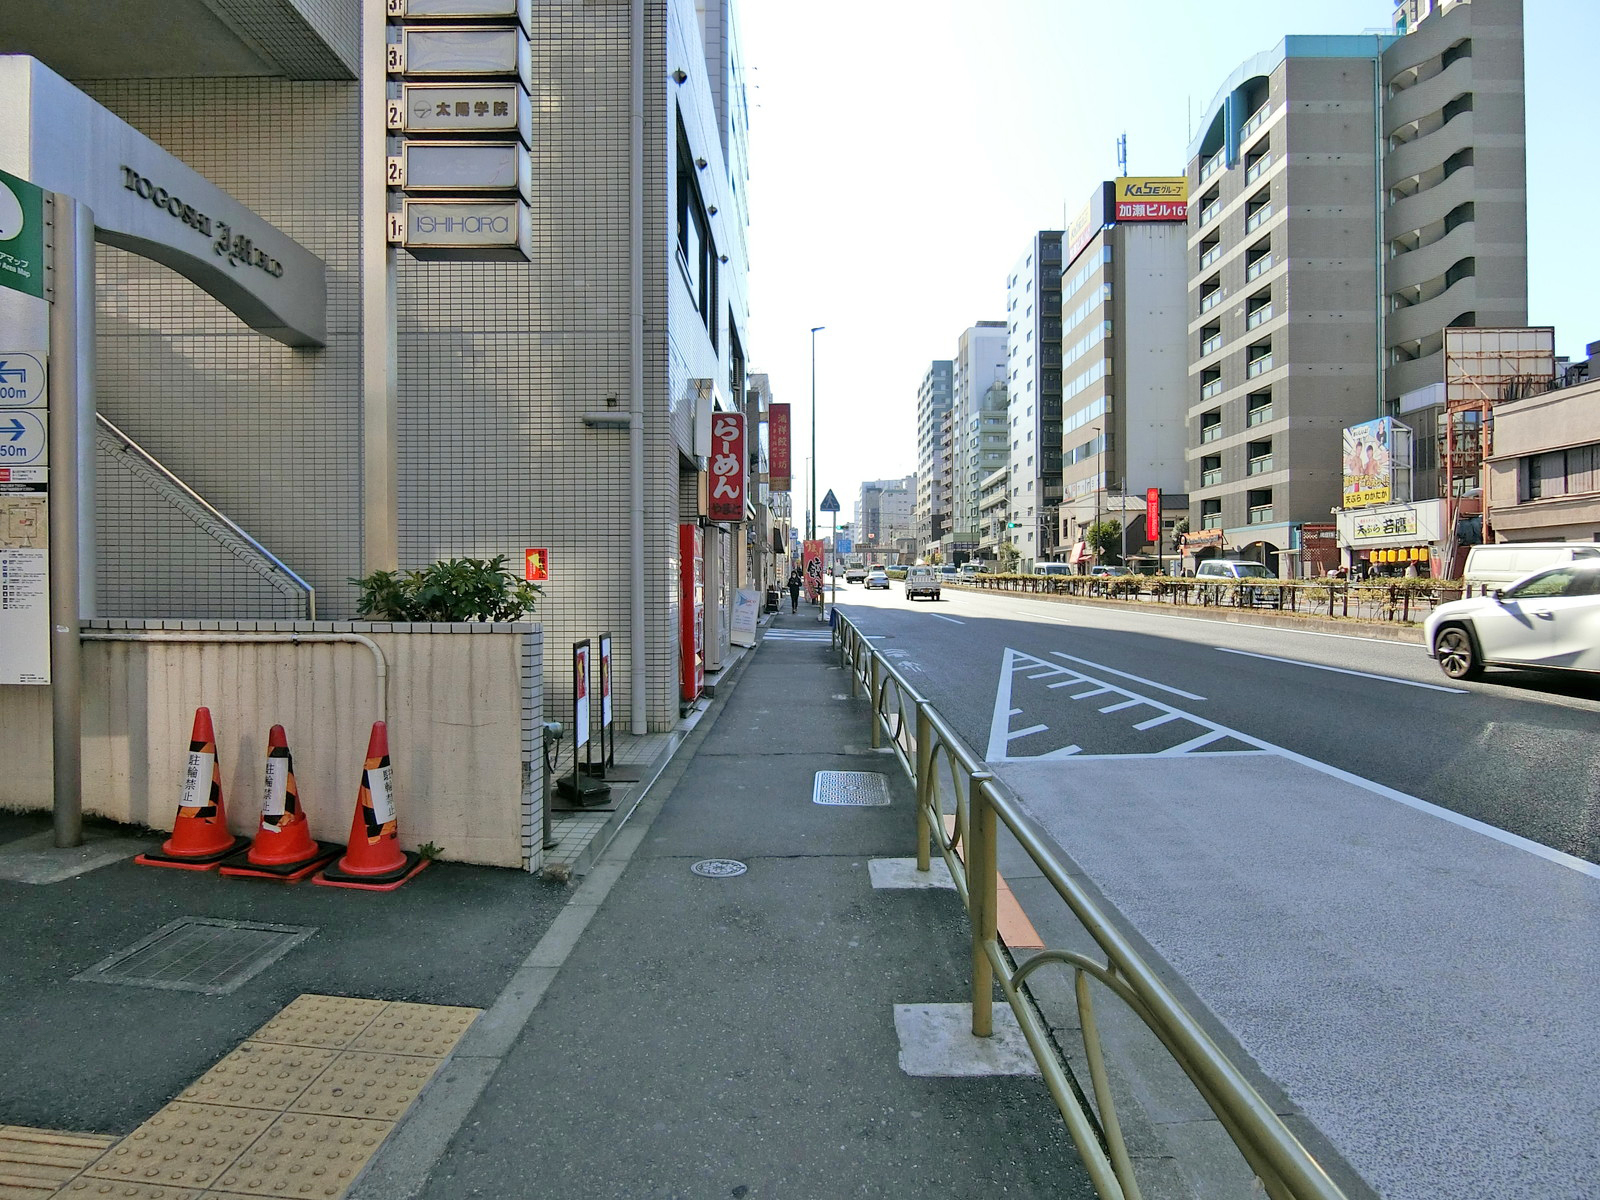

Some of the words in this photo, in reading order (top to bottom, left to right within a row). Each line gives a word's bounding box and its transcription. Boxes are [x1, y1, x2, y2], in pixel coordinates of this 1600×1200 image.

[436, 101, 508, 117] 太陽学院
[120, 164, 213, 238] TOGOSHI
[17, 267, 31, 278] Map
[714, 417, 740, 499] らーめん
[183, 754, 201, 802] 駐輪禁止
